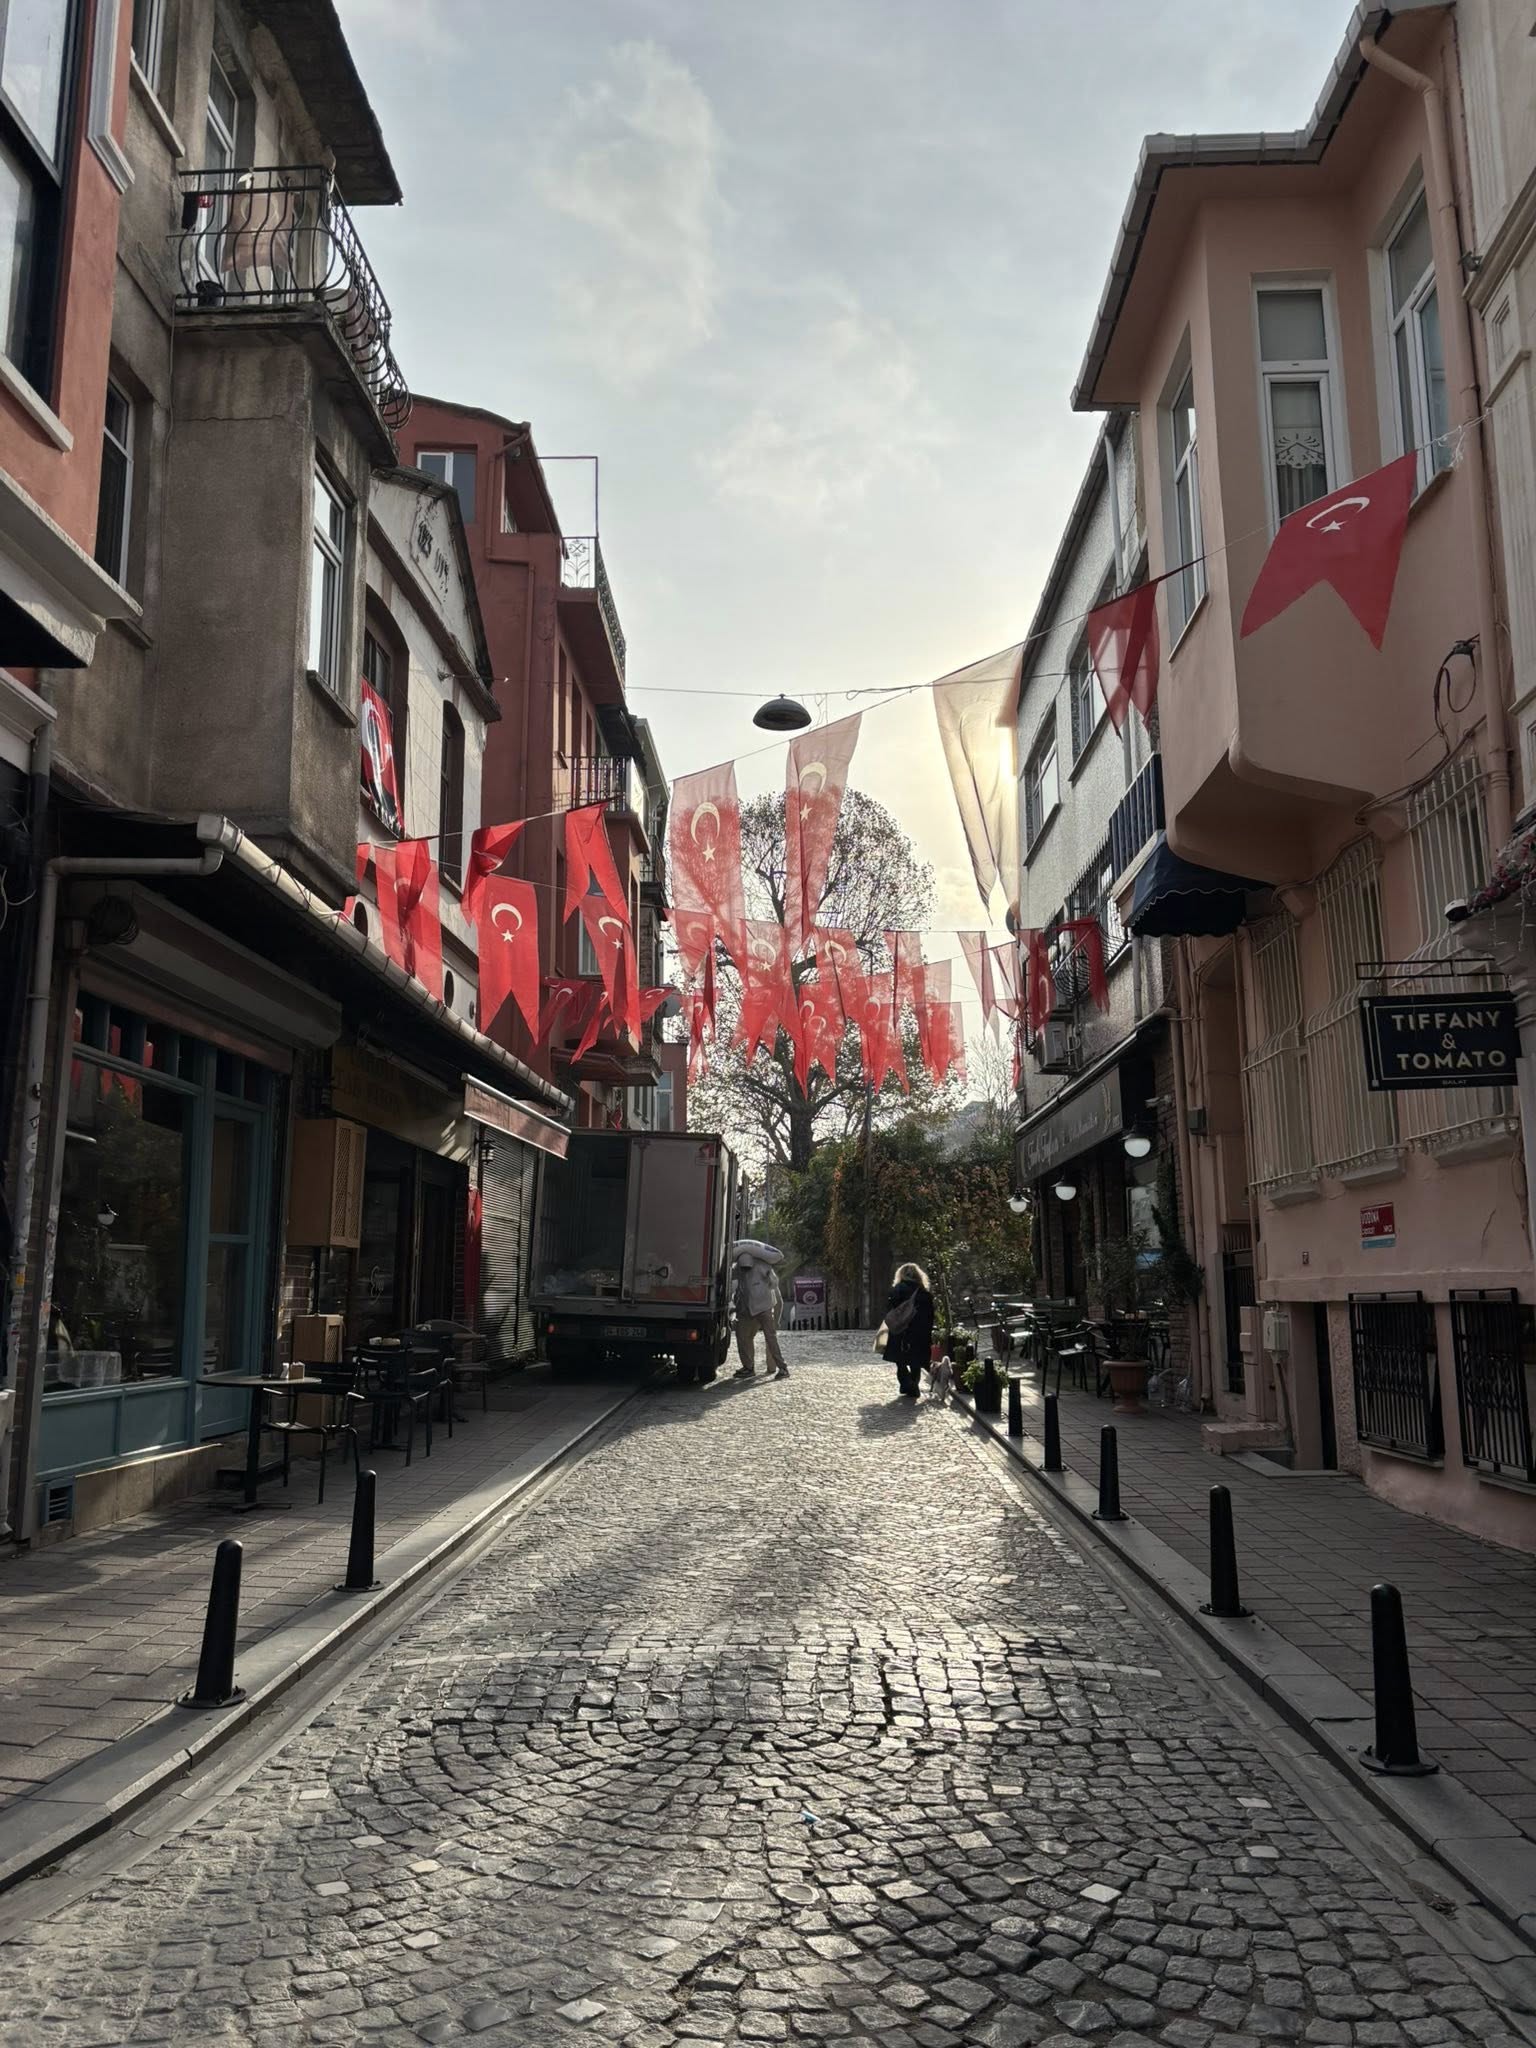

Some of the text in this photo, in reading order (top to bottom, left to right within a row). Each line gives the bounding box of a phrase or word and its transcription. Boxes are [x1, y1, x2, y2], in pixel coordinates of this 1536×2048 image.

[1391, 1011, 1500, 1031] TIFFANY
[1441, 1033, 1457, 1049] &
[1396, 1050, 1506, 1071] TOMATO
